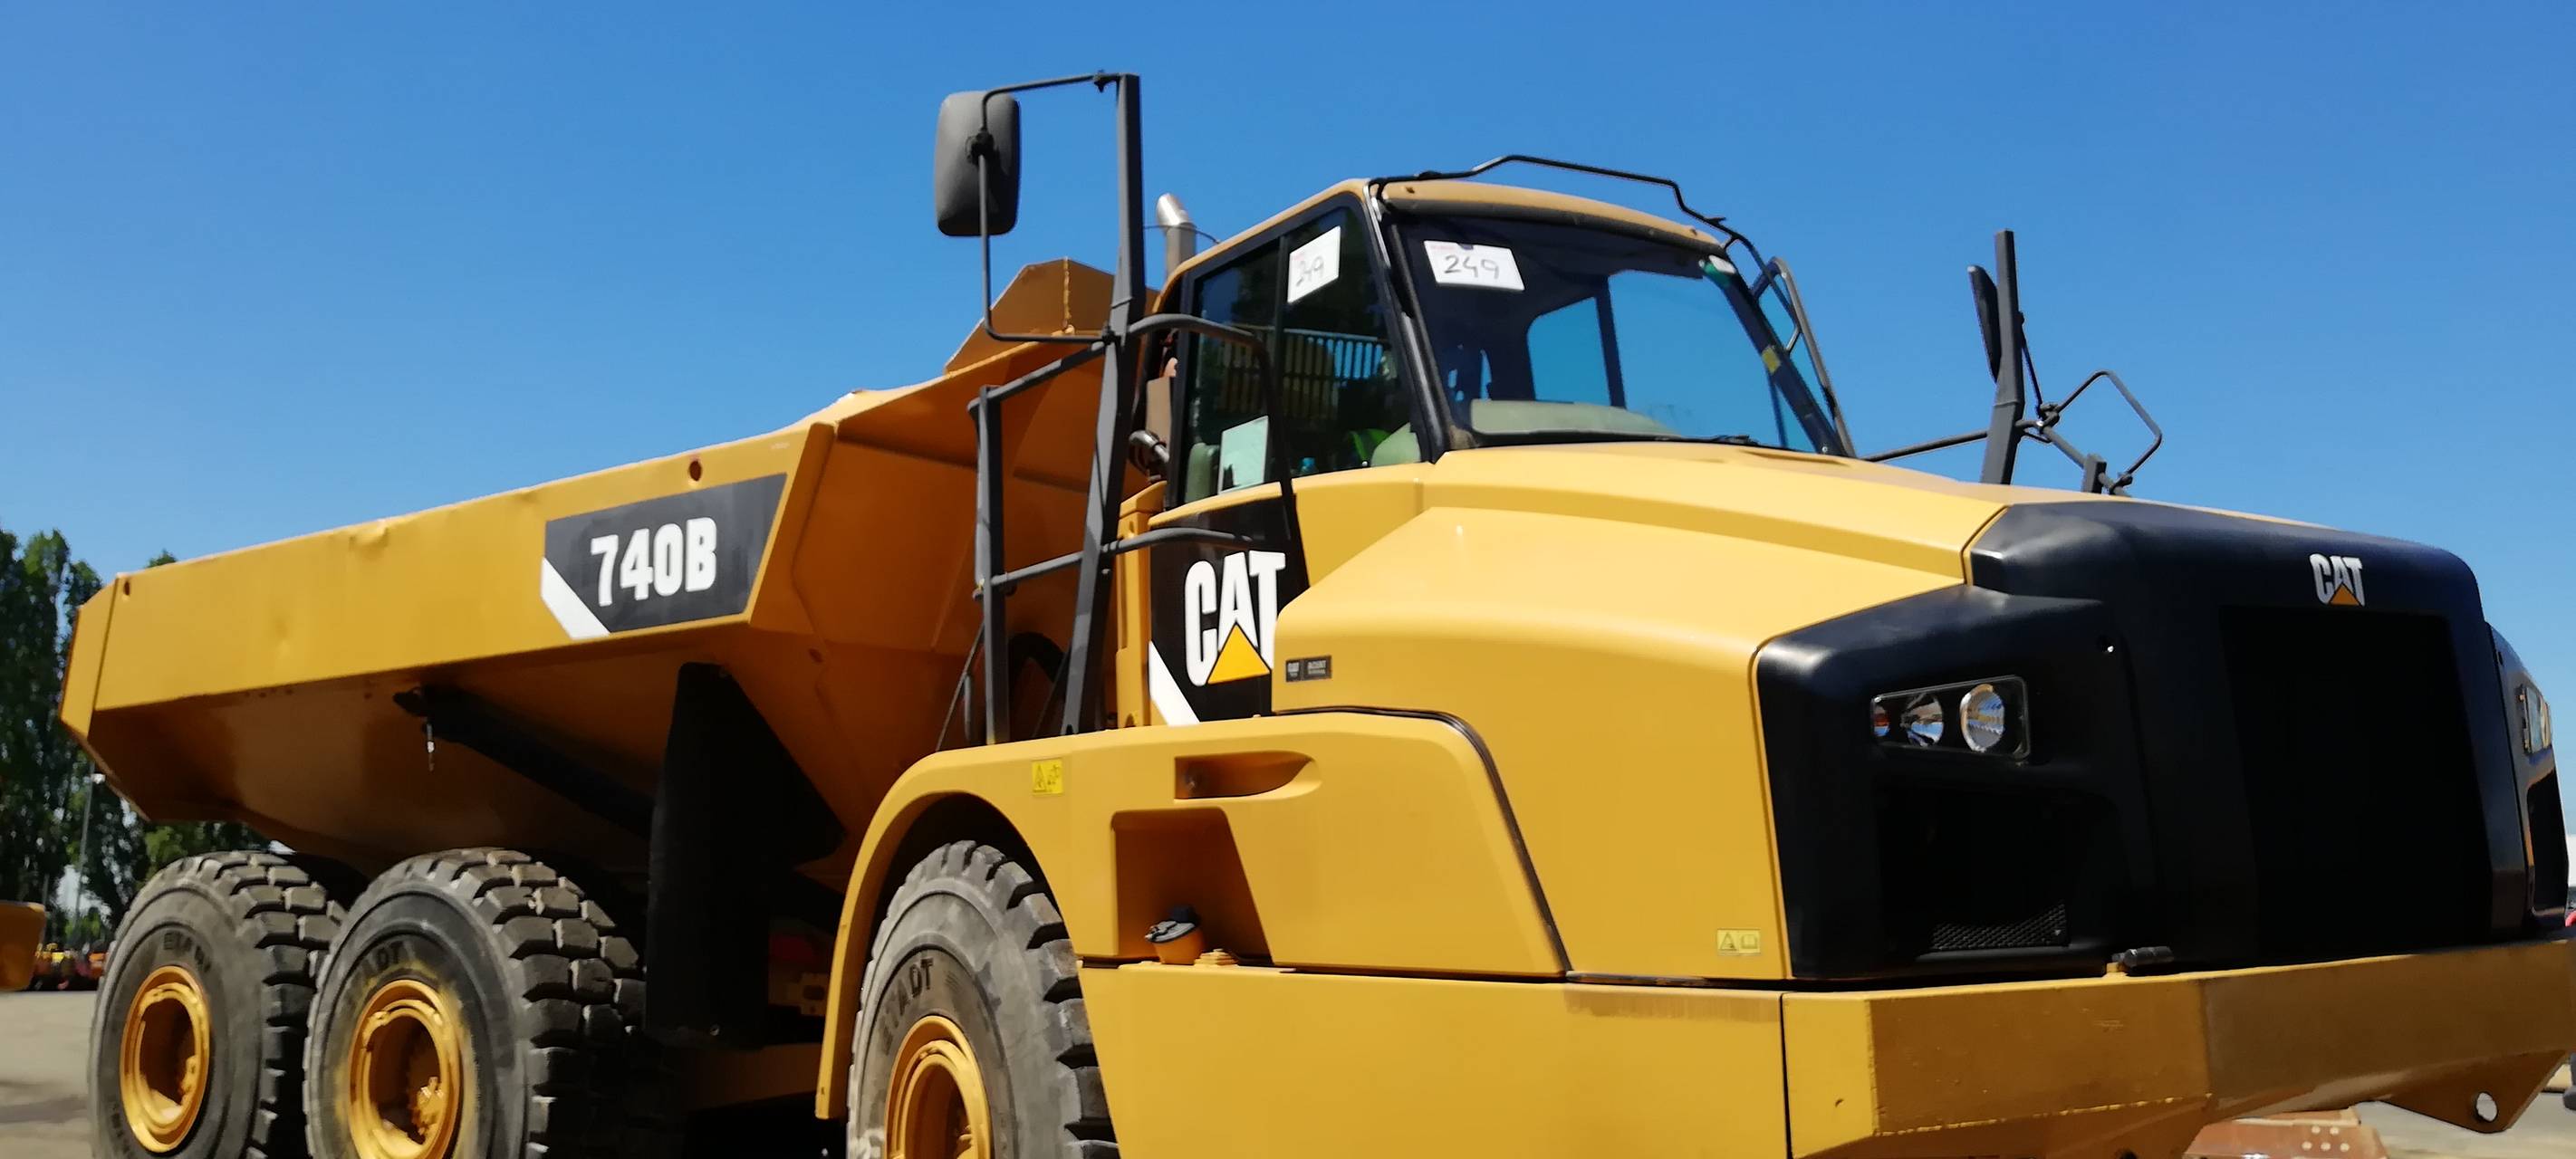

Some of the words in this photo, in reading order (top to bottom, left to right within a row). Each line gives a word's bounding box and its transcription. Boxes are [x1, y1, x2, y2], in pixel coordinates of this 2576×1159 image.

[1296, 255, 1324, 287] 249
[1444, 254, 1500, 280] 249
[590, 517, 717, 608] 740B
[2309, 553, 2366, 607] CAT
[1184, 551, 1286, 686] CAT
